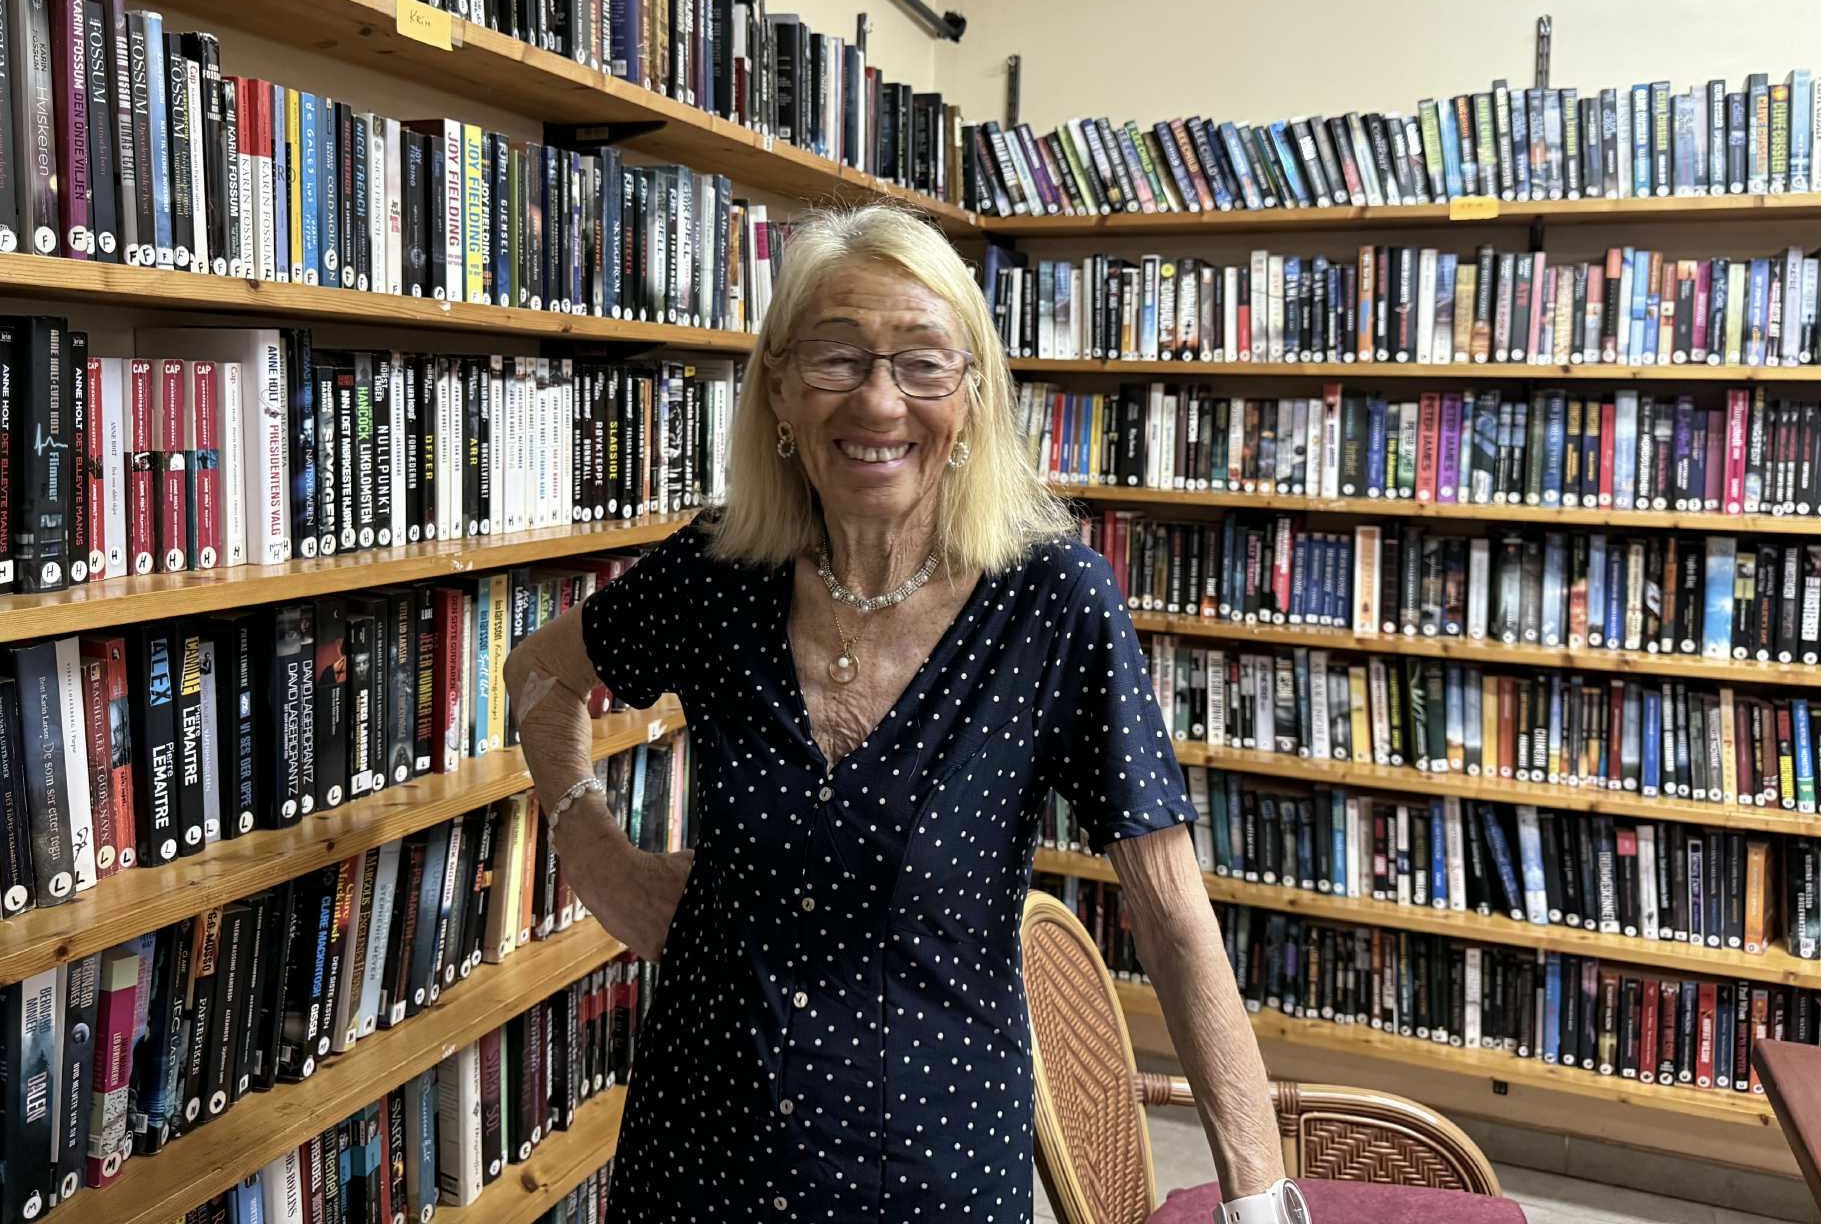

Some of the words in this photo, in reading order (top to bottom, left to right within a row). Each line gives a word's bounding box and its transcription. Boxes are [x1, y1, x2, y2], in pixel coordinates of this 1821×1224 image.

[73, 38, 84, 89] FOSSUM
[89, 21, 105, 104] FOSSUM
[116, 36, 128, 66] KARIN
[117, 70, 130, 109] FOSSUM
[131, 34, 147, 115] FOSSUM
[170, 55, 184, 139] FOSSUM
[35, 86, 50, 176] Hviskeren
[227, 126, 236, 162] KARIN
[357, 122, 365, 159] NICCI
[74, 159, 85, 200] VILJEN
[241, 158, 249, 204] KARIN
[262, 160, 270, 206] KARIN
[409, 144, 417, 187] FIELDING
[229, 165, 239, 217] FOSSUM
[327, 175, 335, 210] COLD
[357, 164, 366, 217] FRENCH
[448, 170, 460, 247] FIELDING
[242, 209, 252, 264] FOSSUM
[469, 176, 481, 253] FIELDING
[482, 206, 490, 264] FIELDING
[263, 211, 271, 266] FOSSUM
[1, 364, 9, 398] ANNE
[75, 367, 83, 399] ANNE
[268, 346, 278, 375] ANNE
[269, 378, 279, 402] HOLT
[1, 400, 9, 430] HOLT
[75, 401, 83, 431] HOLT
[357, 387, 369, 440] HANCOCK
[1423, 396, 1433, 433] PETER
[269, 424, 280, 508] PRESIDENTENS
[377, 425, 390, 515] NULLPUNKT
[425, 435, 433, 481] OFFER
[1422, 434, 1433, 471] JAMES
[1447, 436, 1456, 472] JAMES
[0, 456, 9, 509] ELLEVTE
[49, 452, 59, 503] Flimmer
[75, 453, 83, 503] ELLEVTE
[359, 444, 372, 523] LIKBLOMSTEN
[0, 511, 8, 553] MANUS
[75, 506, 83, 546] MANUS
[271, 510, 281, 536] VALG
[514, 587, 525, 636] LARSSON
[151, 640, 171, 704] ALEX
[287, 662, 298, 700] DAVID
[303, 660, 313, 695] DAVID
[418, 669, 433, 716] NUMMER
[40, 694, 49, 714] Karin
[360, 689, 368, 720] STIEG
[41, 715, 50, 740] Larsen
[183, 706, 198, 786] LEMAITRE
[287, 702, 299, 796] LAGERCRANTZ
[303, 696, 313, 785] LAGERCRANTZ
[359, 723, 368, 772] LARSSON
[418, 718, 432, 741] FIRE
[92, 681, 103, 729] RACHEL
[99, 810, 110, 842] NAVN
[165, 741, 174, 777] Pierre
[152, 744, 169, 830] LEMAITRE
[47, 805, 58, 832] etter
[451, 833, 459, 858] RICK
[319, 896, 331, 929] CLARE
[331, 863, 349, 943] Mackintosh
[343, 883, 354, 918] Clare
[375, 885, 386, 943] STEPHENIE
[80, 958, 95, 1009] BERNARD
[312, 931, 327, 998] MACKINTOSH
[370, 946, 381, 981] MEYER
[39, 987, 52, 1033] BERNARD
[70, 968, 82, 1009] MINIER
[327, 976, 337, 998] SISTE
[24, 998, 38, 1034] MINIER
[191, 997, 207, 1076] PAPIRPIKEN
[307, 1003, 320, 1041] GISSEL
[26, 1071, 48, 1125] DALEN
[311, 1143, 322, 1193] RENDELL
[325, 1150, 338, 1199] Rendell
[286, 1173, 297, 1218] ROLLINS
